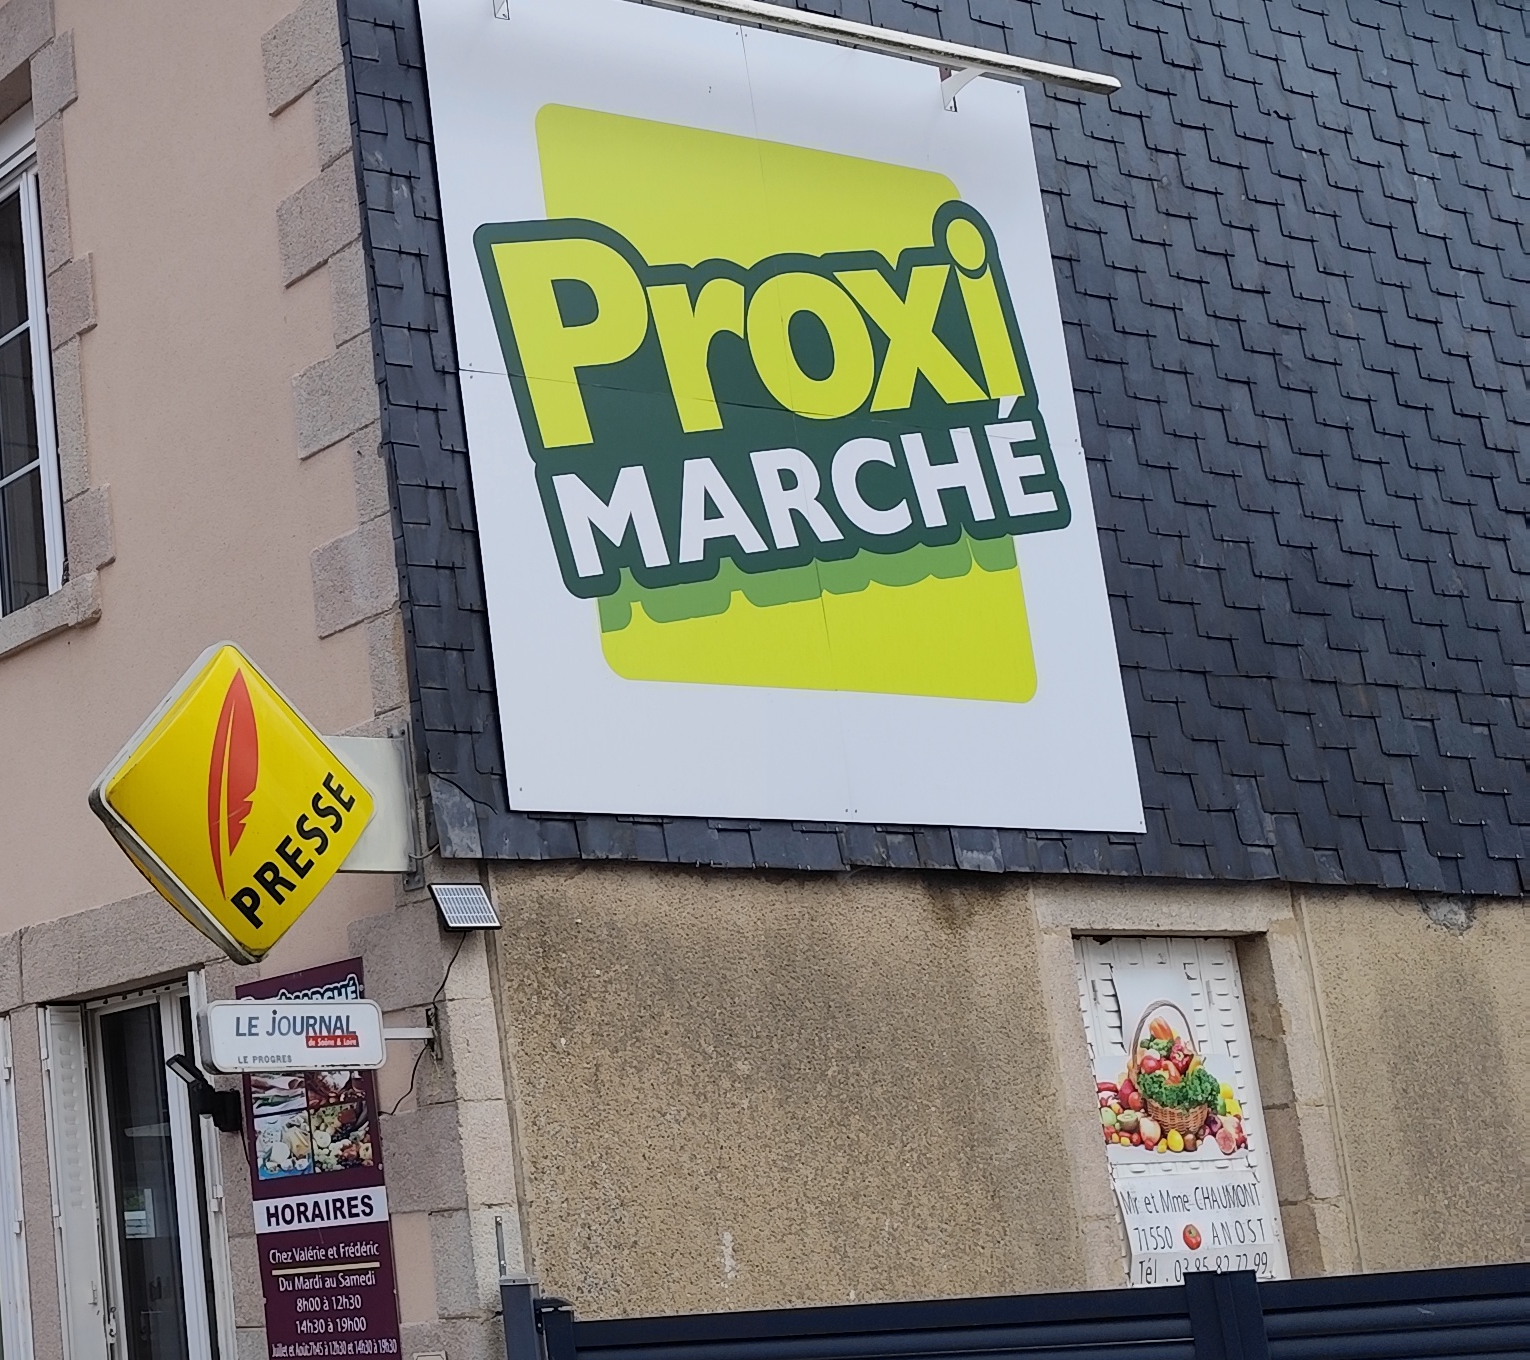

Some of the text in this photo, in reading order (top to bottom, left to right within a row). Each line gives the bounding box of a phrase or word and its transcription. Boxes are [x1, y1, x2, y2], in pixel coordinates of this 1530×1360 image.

[489, 216, 1025, 448] Proxi
[551, 396, 1058, 579] MARCHÉ
[231, 772, 356, 930] PRESSE
[235, 1016, 260, 1037] LE
[337, 1037, 342, 1046] &
[343, 1036, 357, 1046] Loire
[238, 1055, 249, 1064] LE
[1120, 1182, 1261, 1215] Mr et Mme CHAUMONT
[265, 1195, 374, 1227] HORAIRES
[1133, 1225, 1174, 1252] 71550
[269, 1241, 380, 1264] Chez Valérie et Frédéric
[1139, 1258, 1157, 1284] Tél
[1254, 1252, 1268, 1274] 99
[279, 1270, 376, 1291] Du Mardi au Samedi
[296, 1295, 362, 1312] 8h00 à 12h30
[295, 1317, 367, 1334] 14h30 à 19h00
[289, 1344, 296, 1357] et
[324, 1340, 329, 1355] à
[348, 1342, 354, 1354] et
[373, 1339, 378, 1353] à
